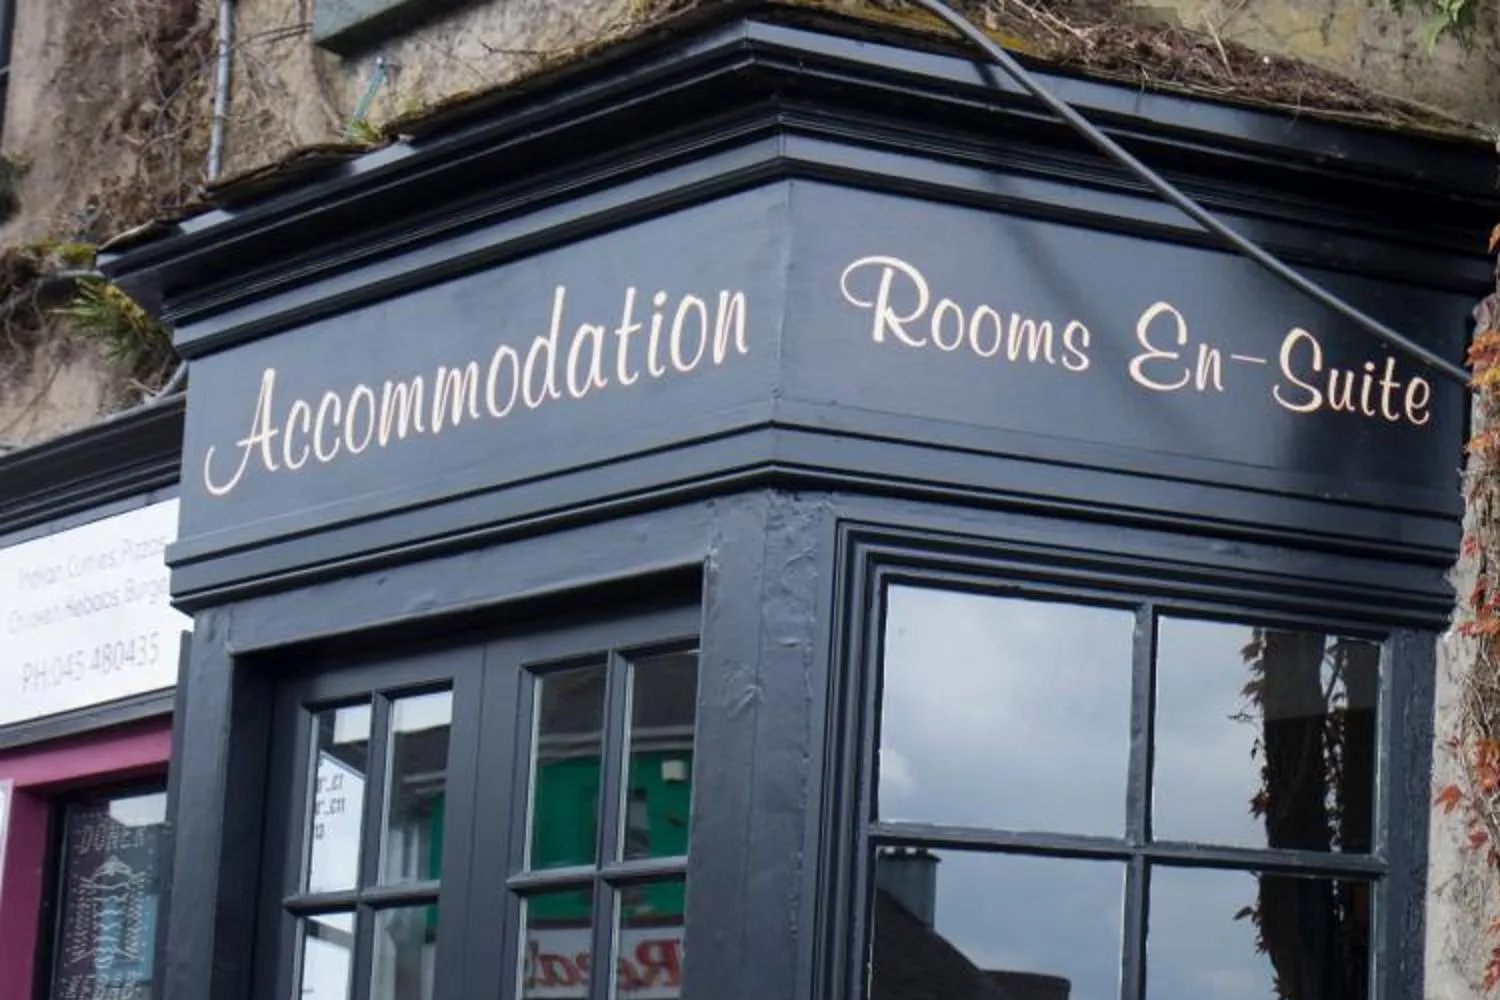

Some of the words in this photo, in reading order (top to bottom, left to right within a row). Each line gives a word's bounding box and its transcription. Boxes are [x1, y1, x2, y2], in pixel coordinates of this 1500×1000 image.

[204, 285, 748, 495] Accommodation
[841, 256, 1092, 371] Rooms
[1128, 301, 1431, 425] En-Suite
[90, 631, 160, 674] 480435
